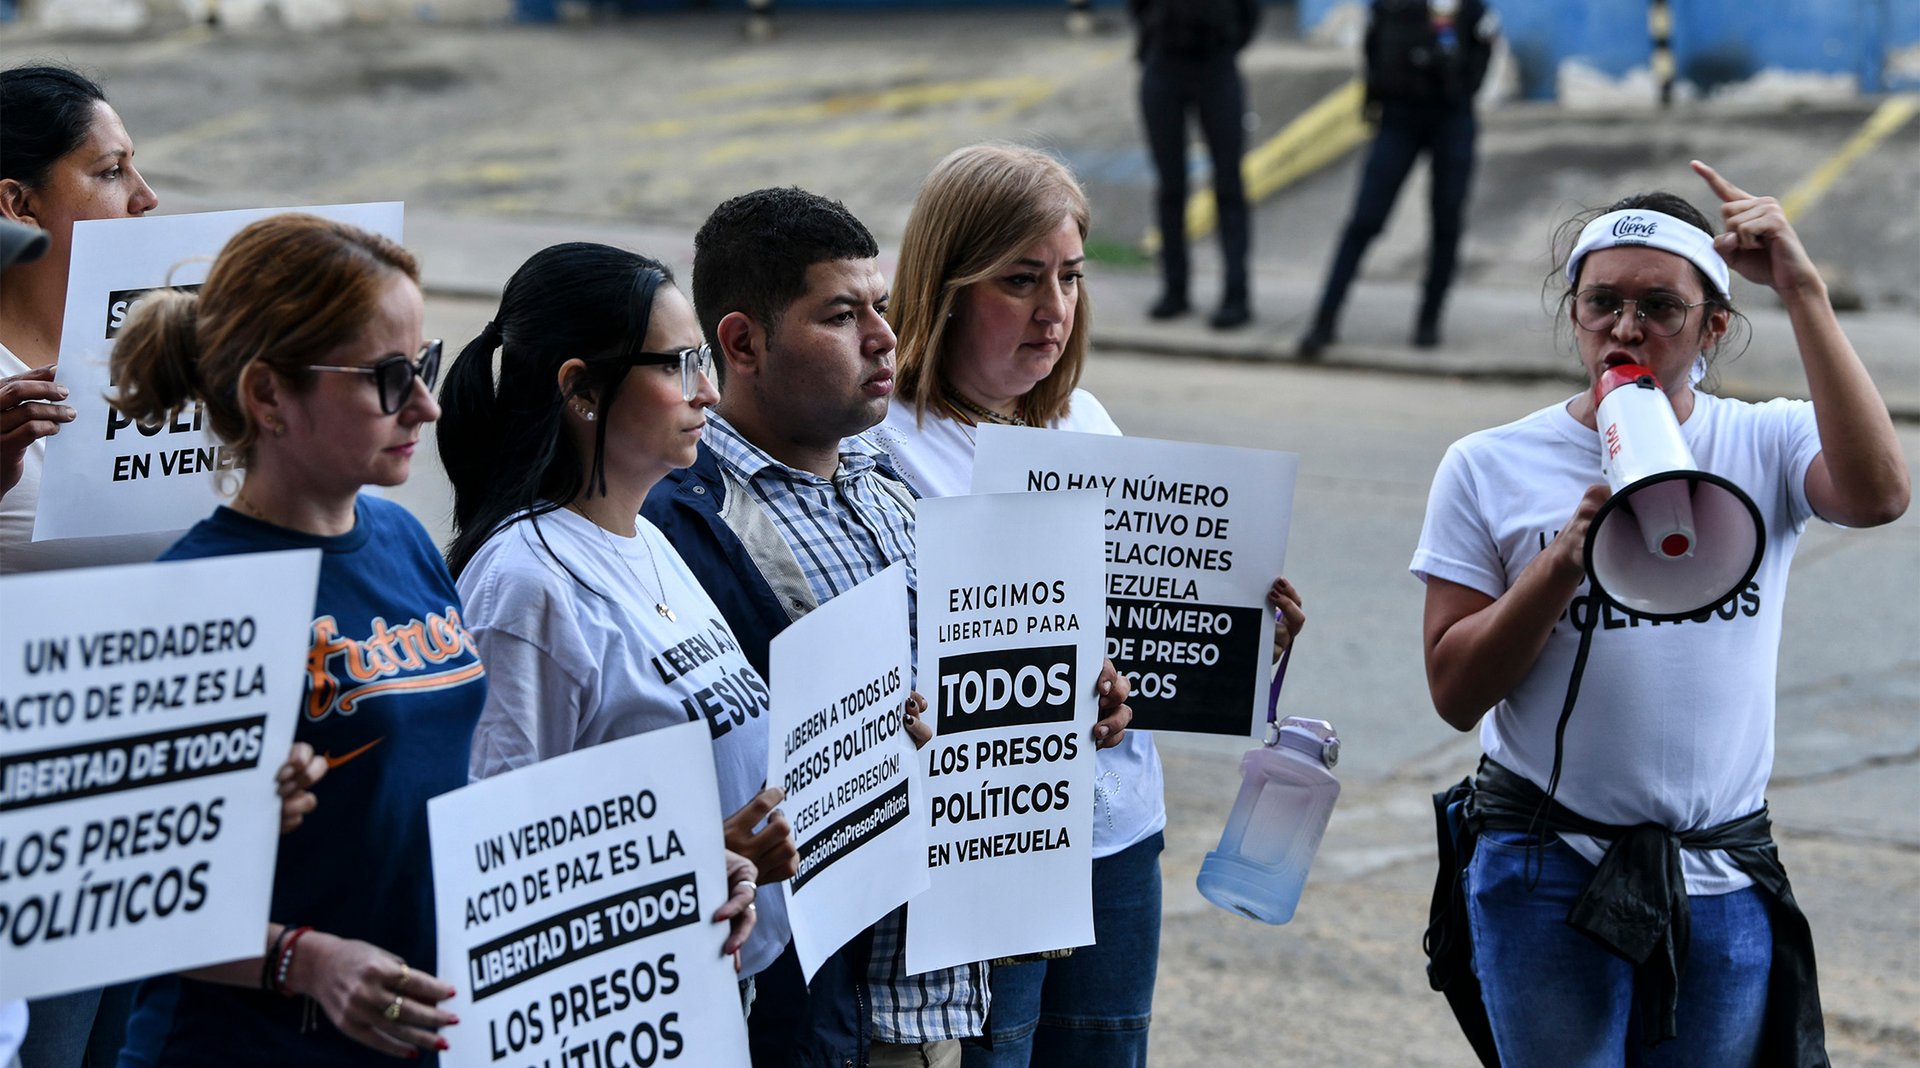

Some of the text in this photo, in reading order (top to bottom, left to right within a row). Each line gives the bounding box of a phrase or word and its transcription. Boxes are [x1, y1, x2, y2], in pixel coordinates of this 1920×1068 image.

[113, 454, 151, 481] EN
[1027, 470, 1229, 507] NO HAY NÚMERO
[1104, 509, 1229, 540] CATIVO DE
[1105, 541, 1233, 572] ELACIONES
[950, 580, 1065, 612] EXIGIMOS
[1105, 573, 1199, 600] EZUELA
[25, 617, 256, 674] UN VERDADERO
[939, 613, 1080, 643] LIBERTAD PARA
[1128, 603, 1232, 635] NÚMERO
[1105, 637, 1219, 665] DE PRESO
[85, 685, 121, 721] DE
[131, 677, 186, 715] PAZ
[194, 669, 226, 706] ES
[234, 665, 265, 698] LA
[785, 666, 900, 763] ¡LIBEREN A TODOS LOS
[941, 662, 1072, 717] TODOS
[0, 725, 263, 802] IBERTAD DE TODOS
[784, 746, 830, 801] PRESOS
[929, 733, 1078, 777] LOS PRESOS
[793, 753, 899, 841] ¡CESE LA REPRESIÓN!
[931, 780, 1070, 827] POLÍTICOS
[0, 799, 226, 880] LOS PRESOS
[475, 789, 657, 874] UN VERDADERO
[791, 793, 907, 884] ransiciónSinPresosPolíticos
[928, 827, 1070, 868] EN VENEZUELA
[465, 829, 686, 930] ACTO DE PAZ ES LA
[470, 884, 697, 991] LIBERTAD DE TODOS
[490, 953, 680, 1062] LOS PRESOS
